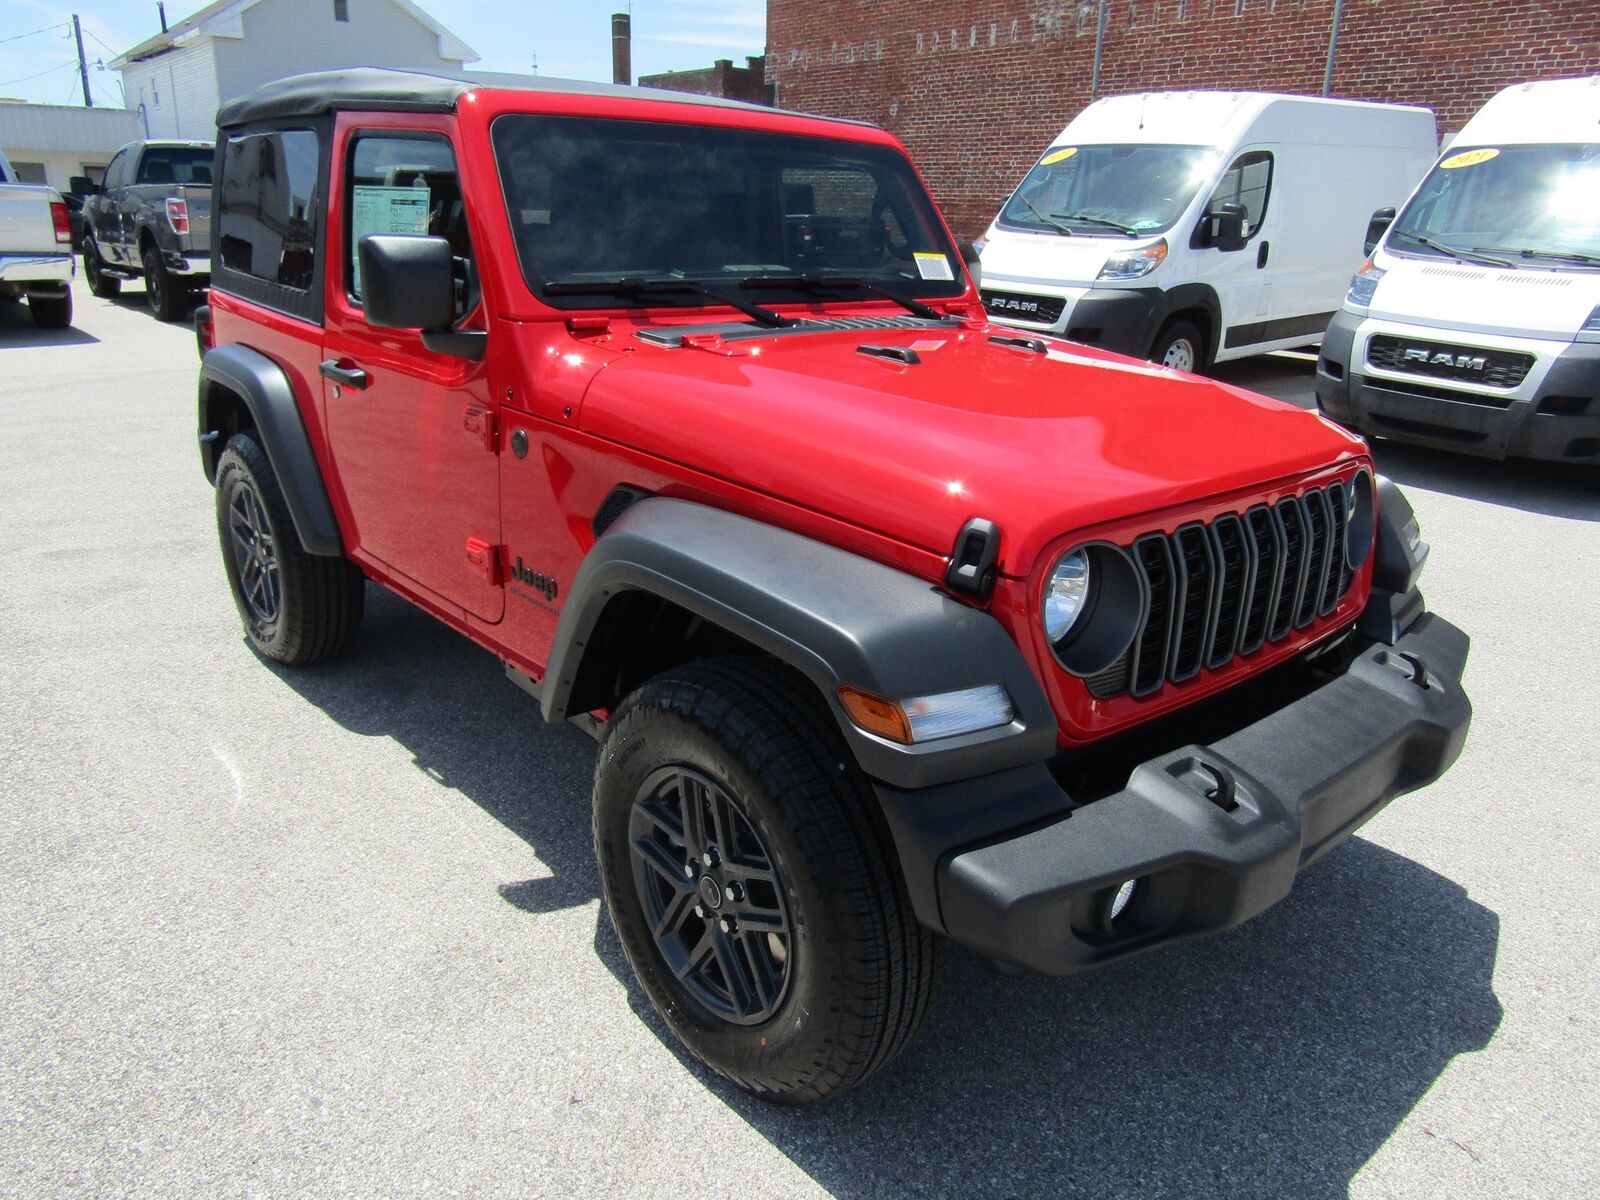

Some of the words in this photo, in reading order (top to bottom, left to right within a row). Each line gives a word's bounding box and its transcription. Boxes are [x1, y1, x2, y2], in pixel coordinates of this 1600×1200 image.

[991, 298, 1037, 312] RAM
[1404, 348, 1487, 370] RAM
[509, 556, 558, 602] Jeep
